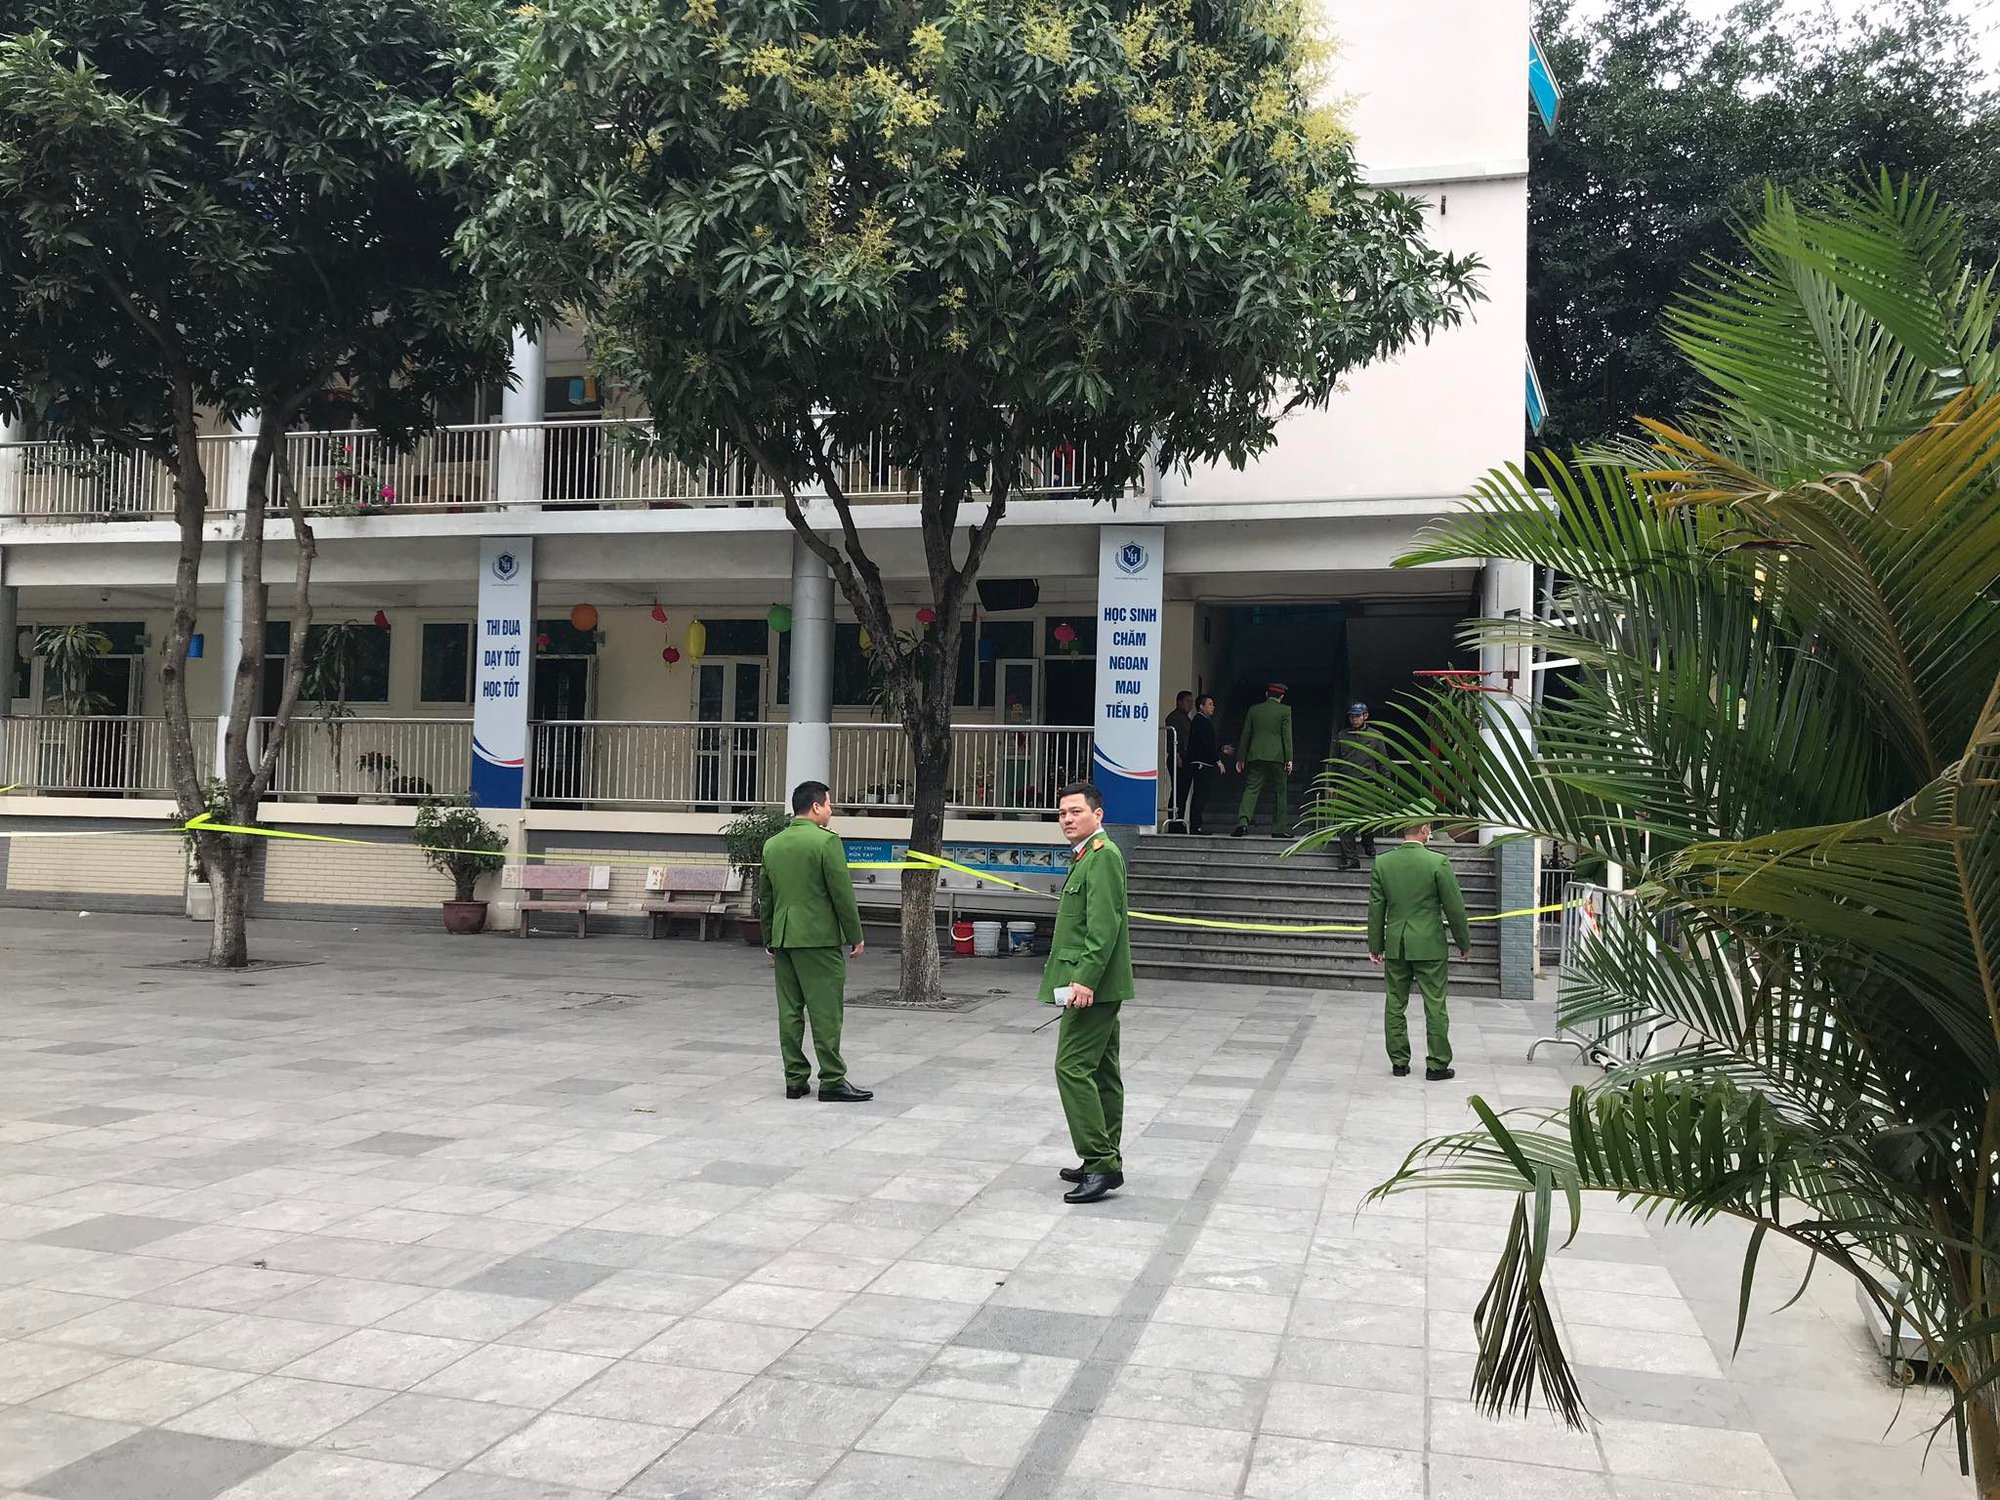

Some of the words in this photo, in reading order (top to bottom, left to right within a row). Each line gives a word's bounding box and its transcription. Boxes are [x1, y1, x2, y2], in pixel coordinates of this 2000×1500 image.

[1104, 607, 1127, 625] HỌC
[1129, 608, 1157, 622] SINH
[486, 620, 501, 636] THI
[502, 620, 521, 636] ĐUA
[1113, 629, 1147, 647] CHĂM
[484, 651, 503, 670] DẠY
[504, 645, 521, 668] TỐT
[1109, 655, 1149, 671] NGOAN
[483, 681, 502, 701] HỌC
[503, 675, 520, 698] TỐT
[1115, 680, 1141, 695] MAU
[1105, 700, 1131, 719] TIẾN
[1133, 702, 1149, 723] BỘ
